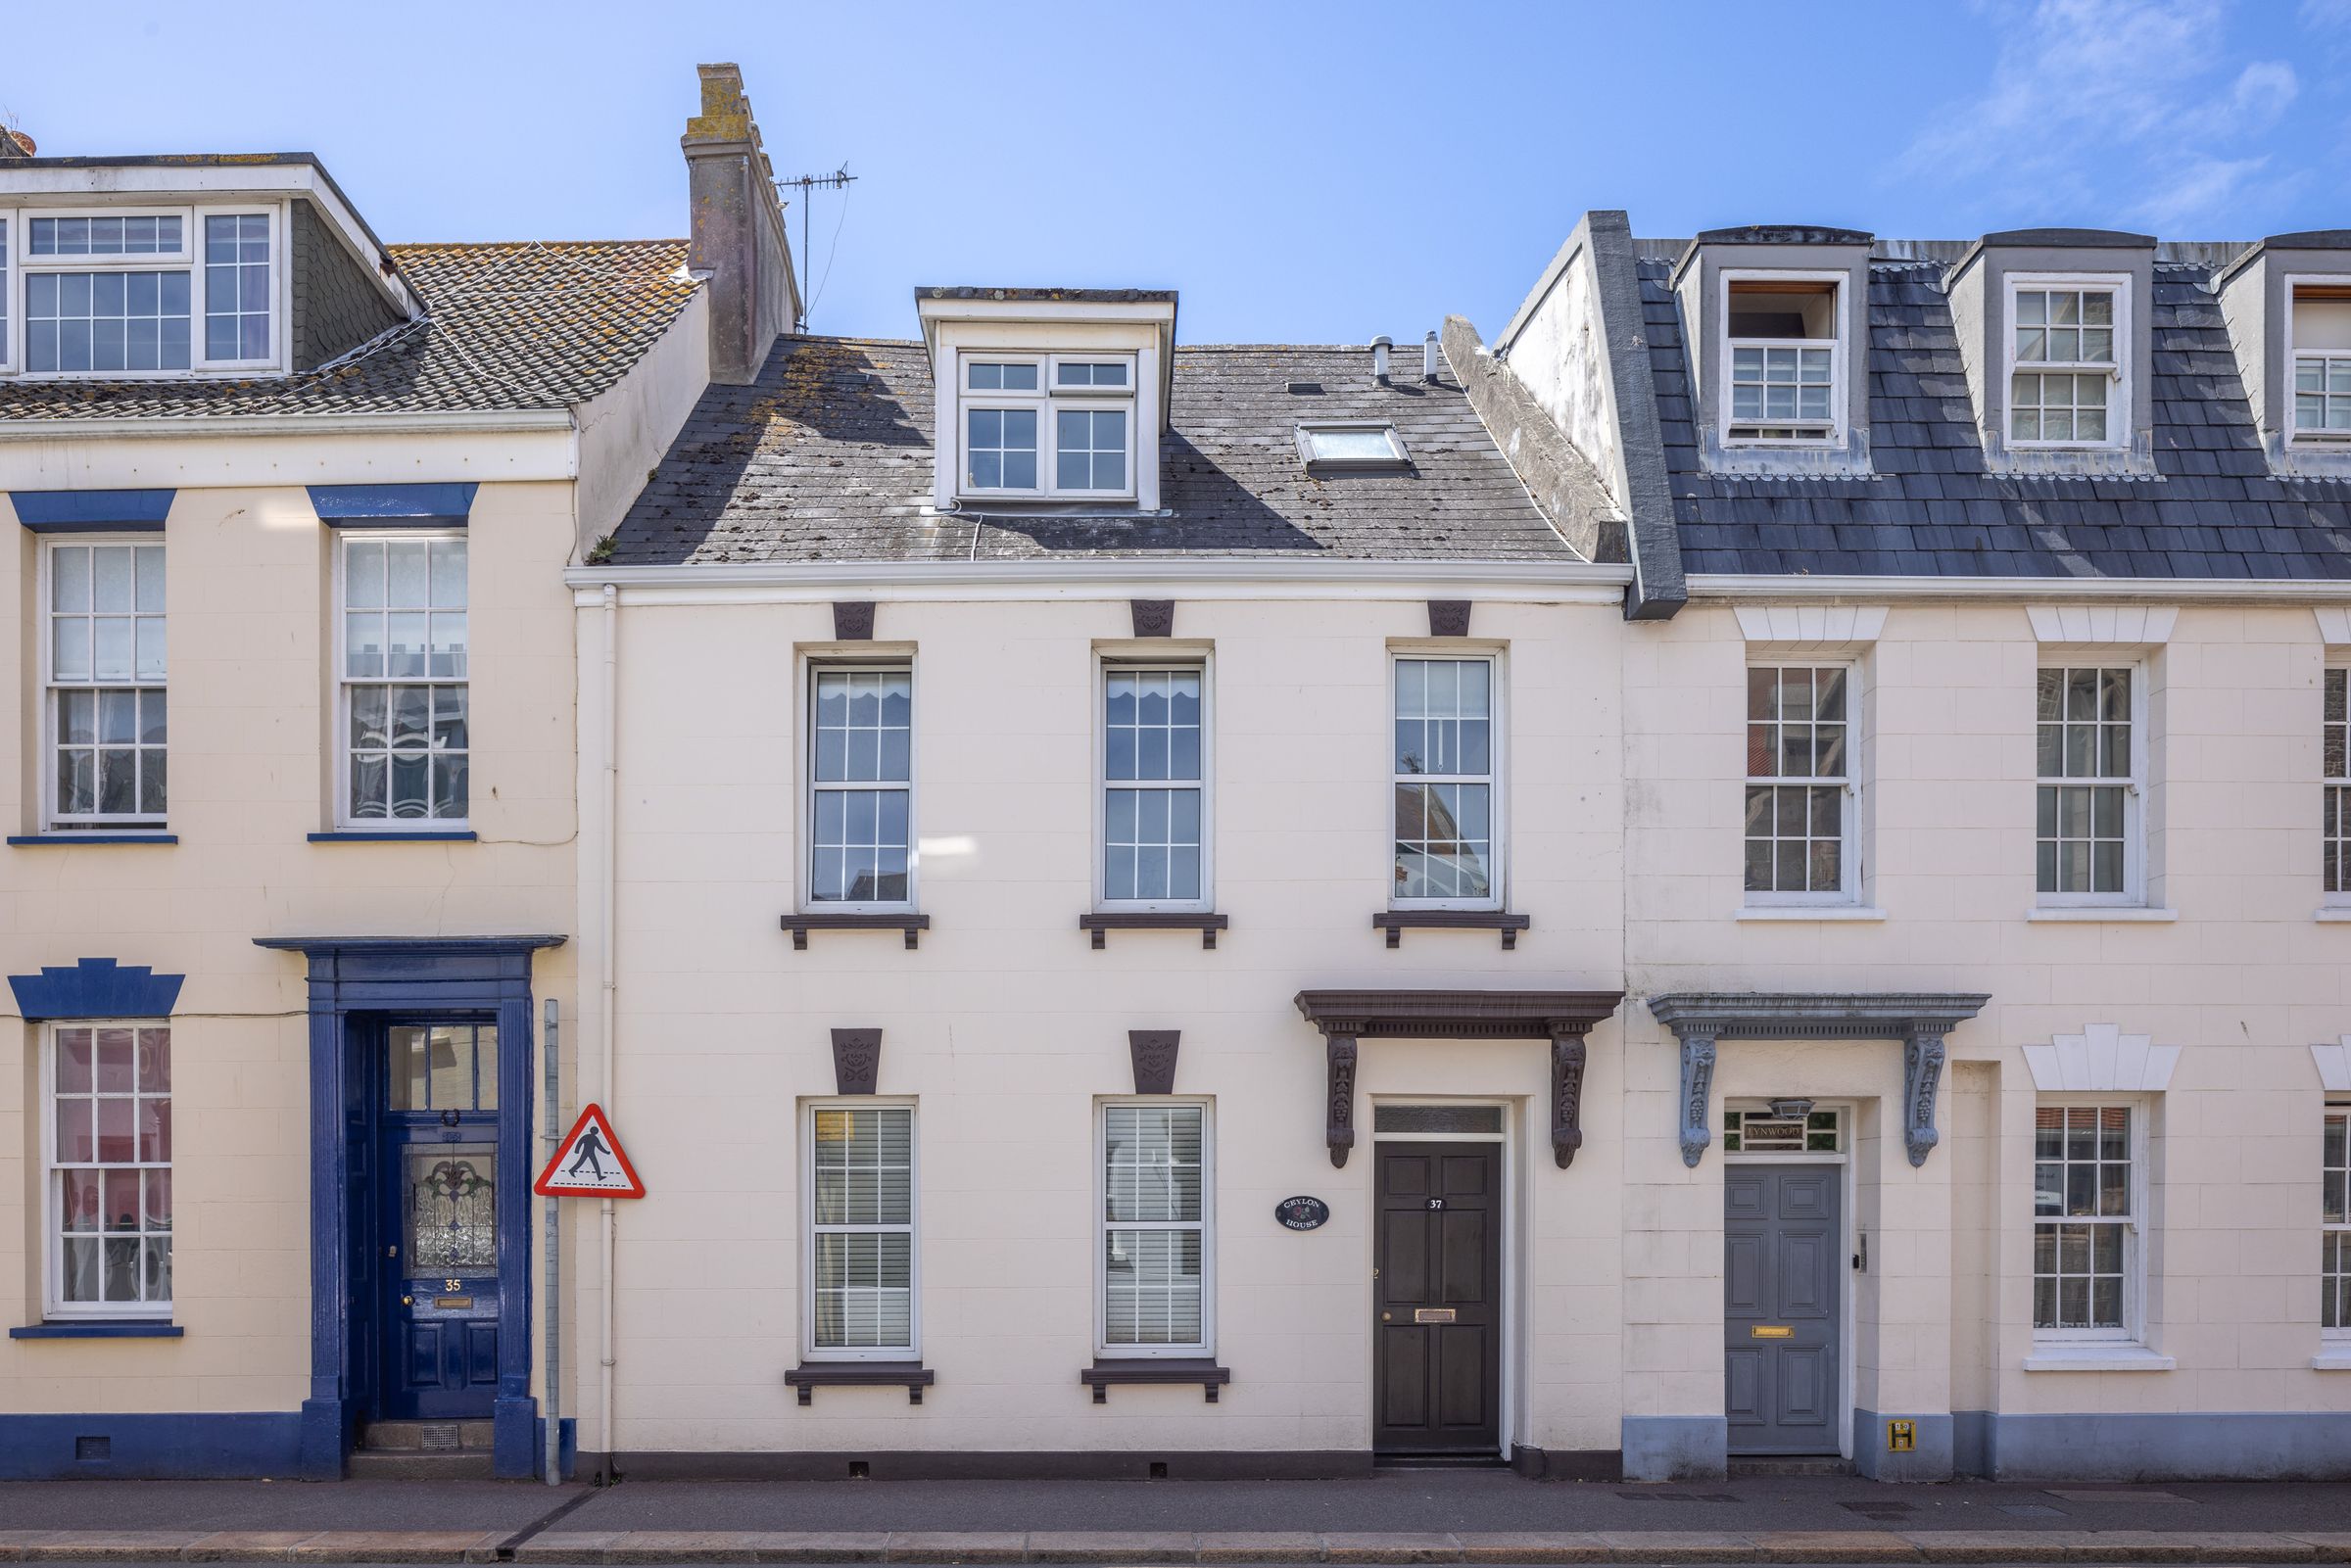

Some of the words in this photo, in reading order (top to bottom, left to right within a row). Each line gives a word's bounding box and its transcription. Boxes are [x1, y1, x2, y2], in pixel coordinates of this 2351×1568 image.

[1748, 1127, 1799, 1136] LYNWOOD
[1283, 1198, 1319, 1209] CEYLON
[1429, 1199, 1442, 1210] 37
[1286, 1218, 1319, 1229] HOUSE
[445, 1278, 461, 1292] 35
